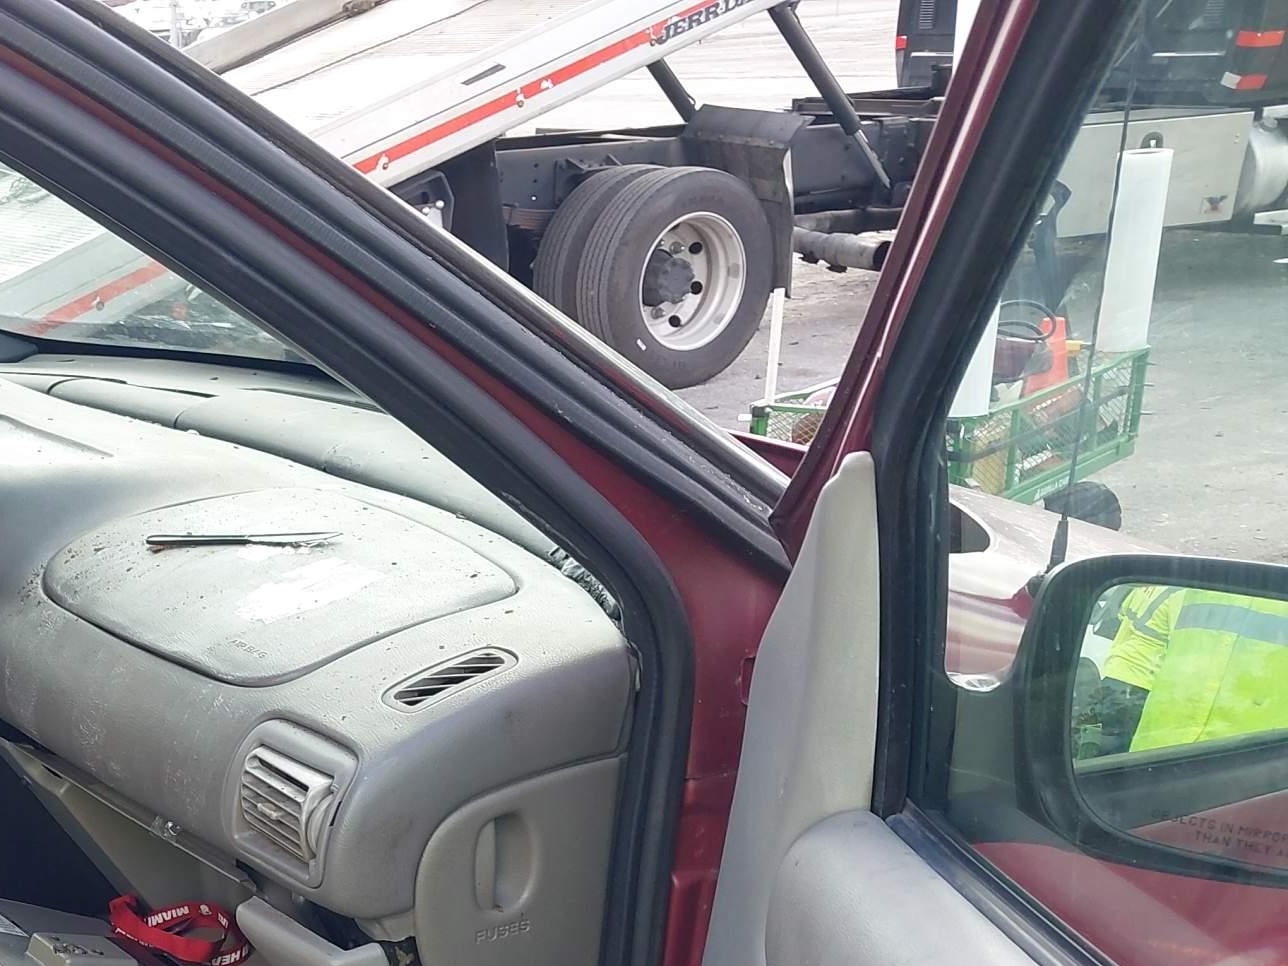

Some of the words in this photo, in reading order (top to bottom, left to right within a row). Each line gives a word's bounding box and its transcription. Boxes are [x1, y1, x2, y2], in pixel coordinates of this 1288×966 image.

[1221, 821, 1233, 834] IN
[1195, 831, 1230, 847] THAN
[147, 906, 189, 928] MIAMI
[475, 920, 531, 944] FUSES
